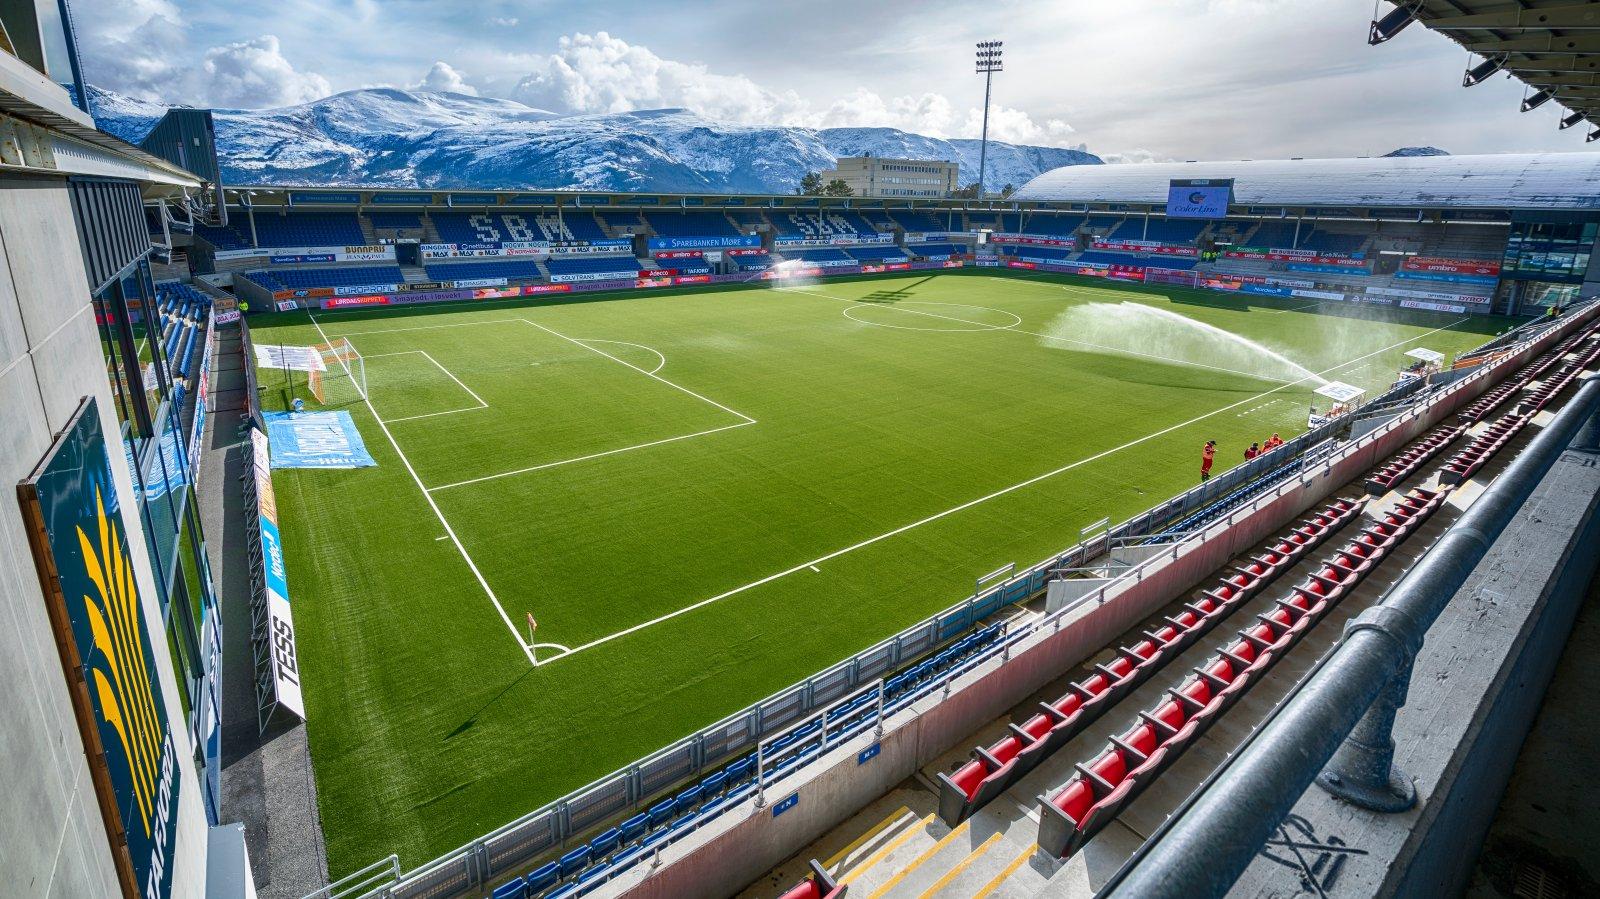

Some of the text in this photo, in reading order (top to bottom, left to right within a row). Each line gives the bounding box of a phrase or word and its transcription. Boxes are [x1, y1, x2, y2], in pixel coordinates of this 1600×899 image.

[672, 238, 740, 248] SPAREBANKEN MØRE
[337, 286, 396, 294] EUROPROFIL
[270, 538, 284, 582] Nordea
[272, 616, 299, 687] TESS
